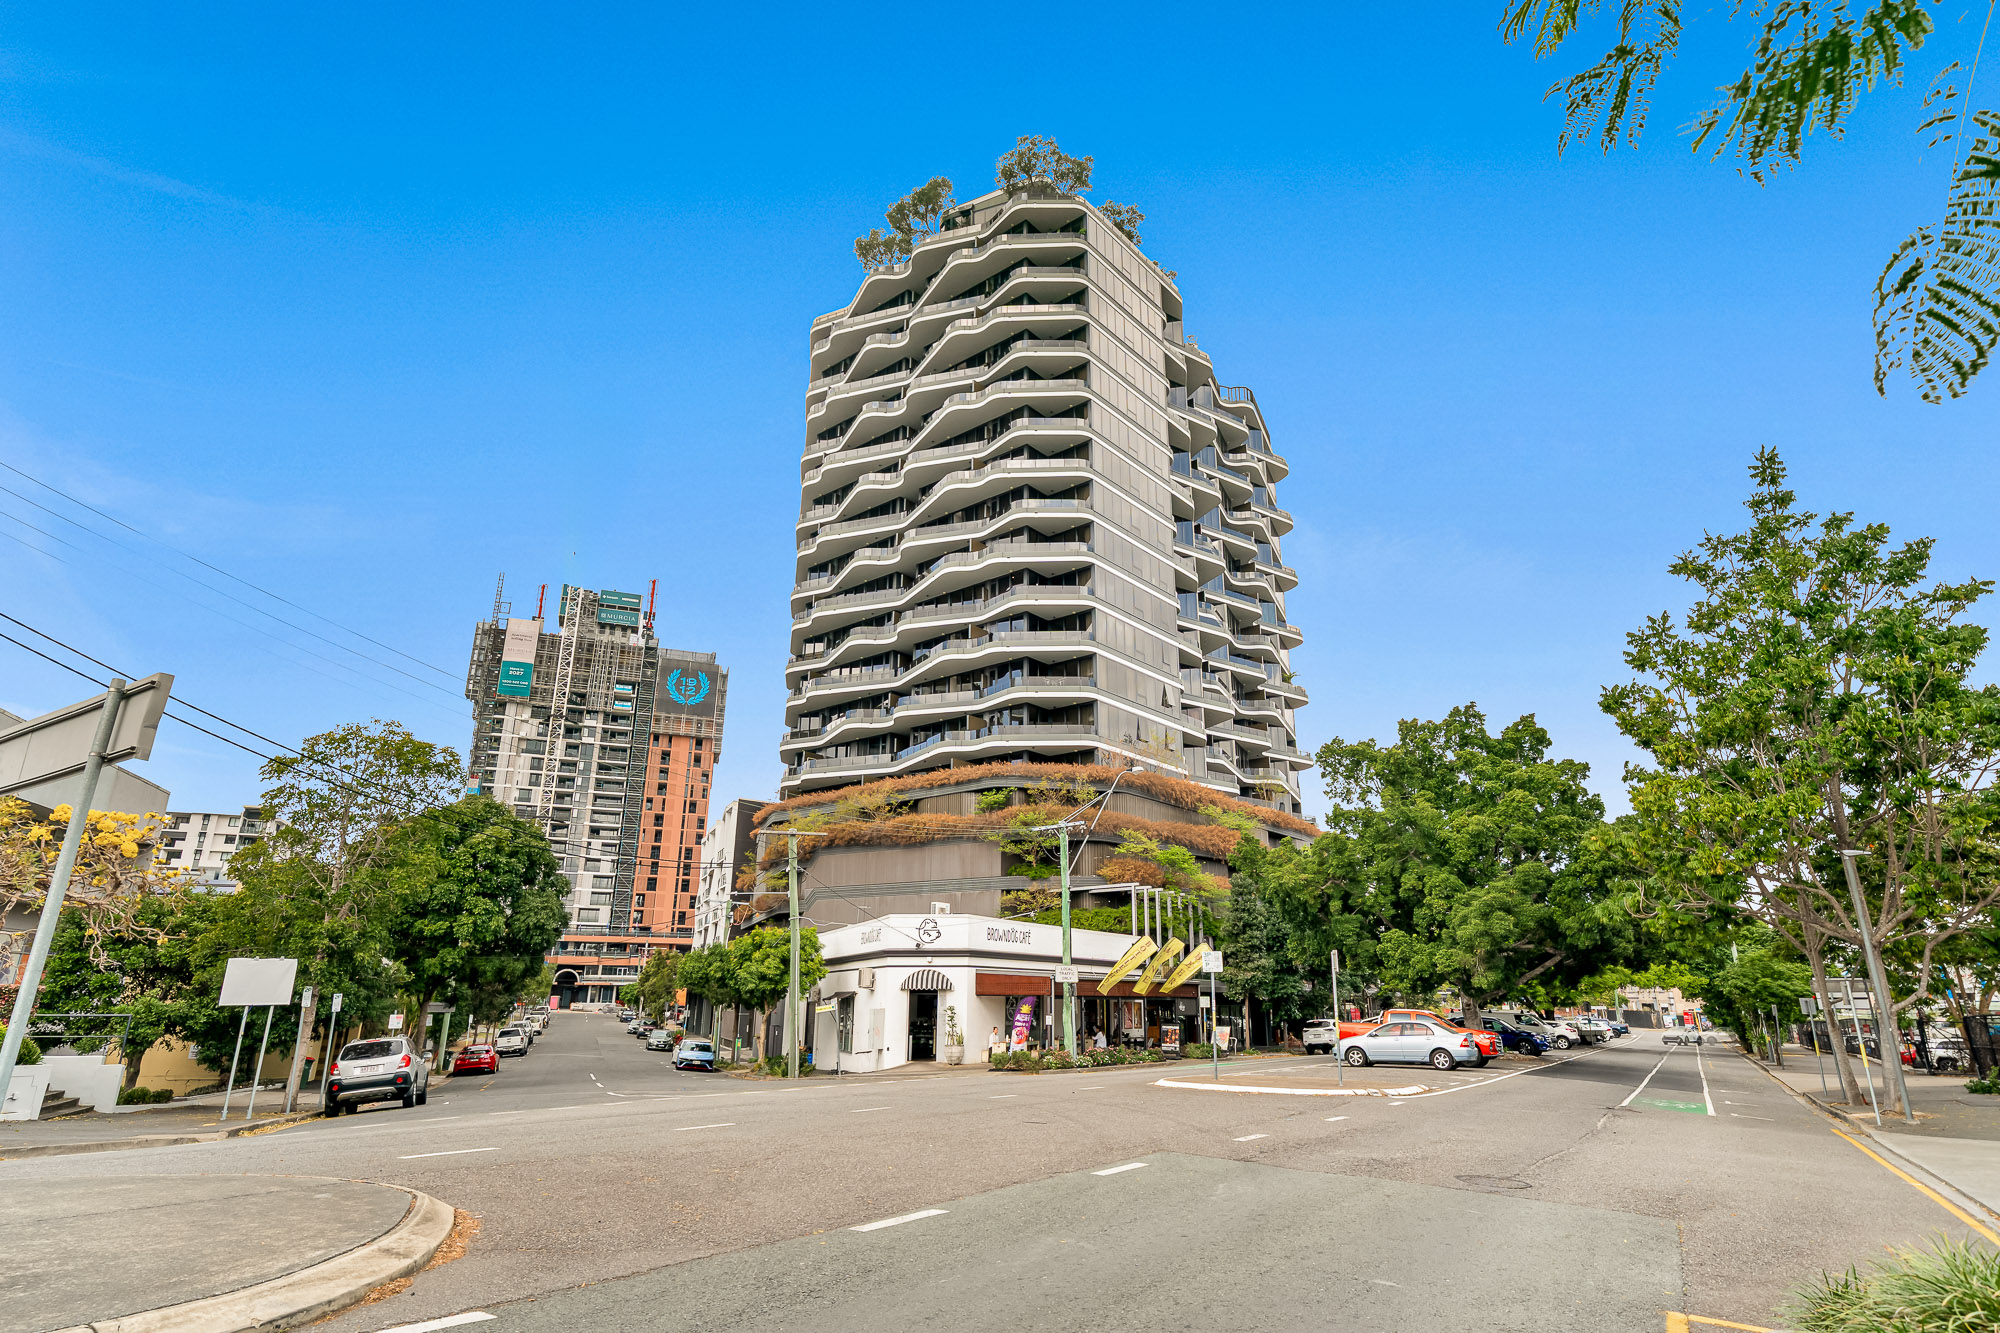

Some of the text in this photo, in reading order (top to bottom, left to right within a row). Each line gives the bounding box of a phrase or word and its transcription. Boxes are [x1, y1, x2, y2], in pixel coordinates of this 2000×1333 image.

[606, 613, 636, 622] MURCIA
[680, 677, 697, 686] 19
[680, 686, 696, 695] 12
